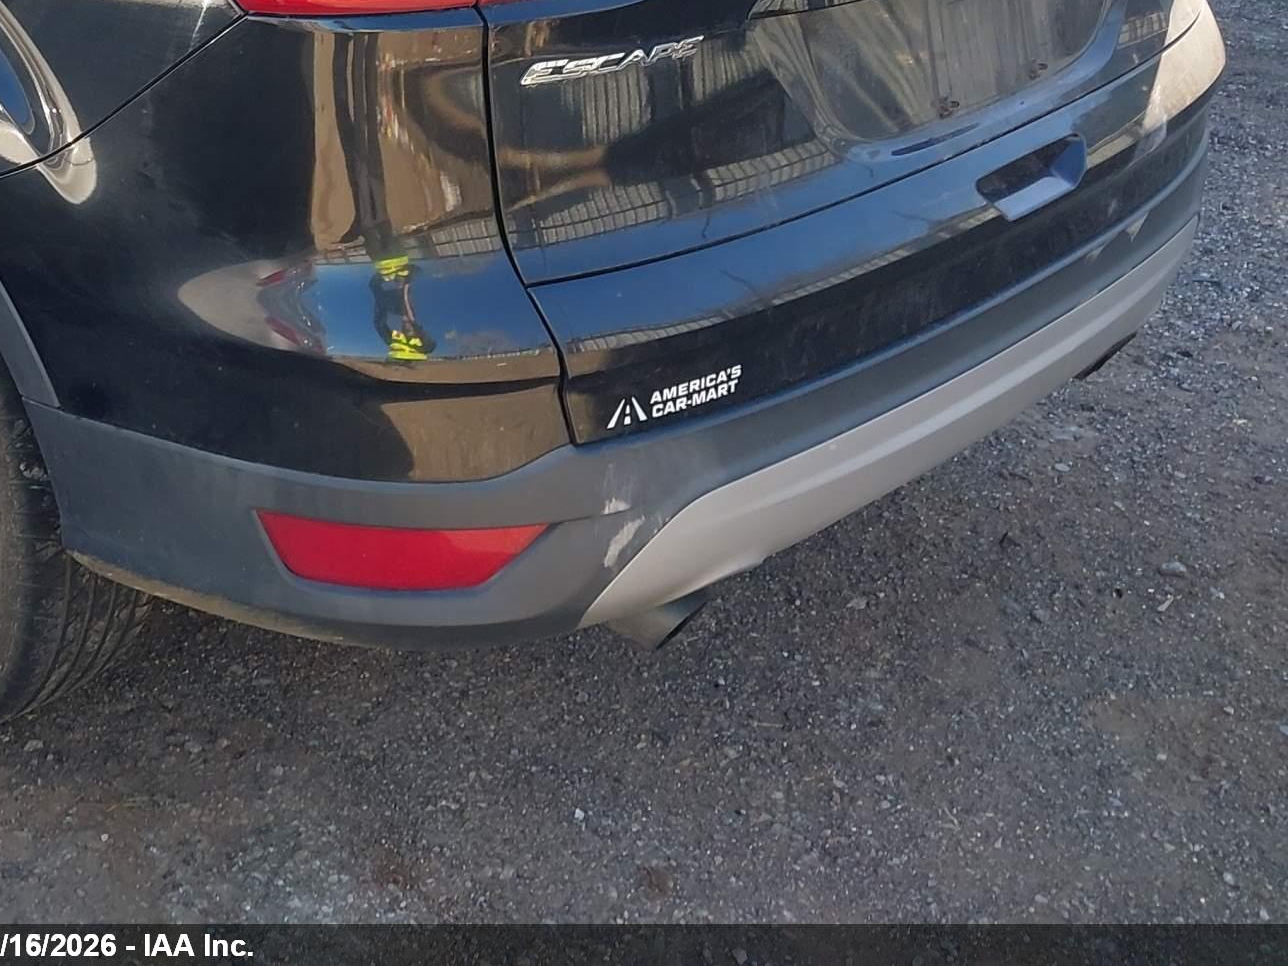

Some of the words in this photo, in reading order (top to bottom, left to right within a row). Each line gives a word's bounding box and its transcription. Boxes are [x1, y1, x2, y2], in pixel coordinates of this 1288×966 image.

[520, 34, 705, 86] ESCAPE
[650, 364, 742, 405] AMERICA'S
[651, 379, 739, 419] CAR-MART
